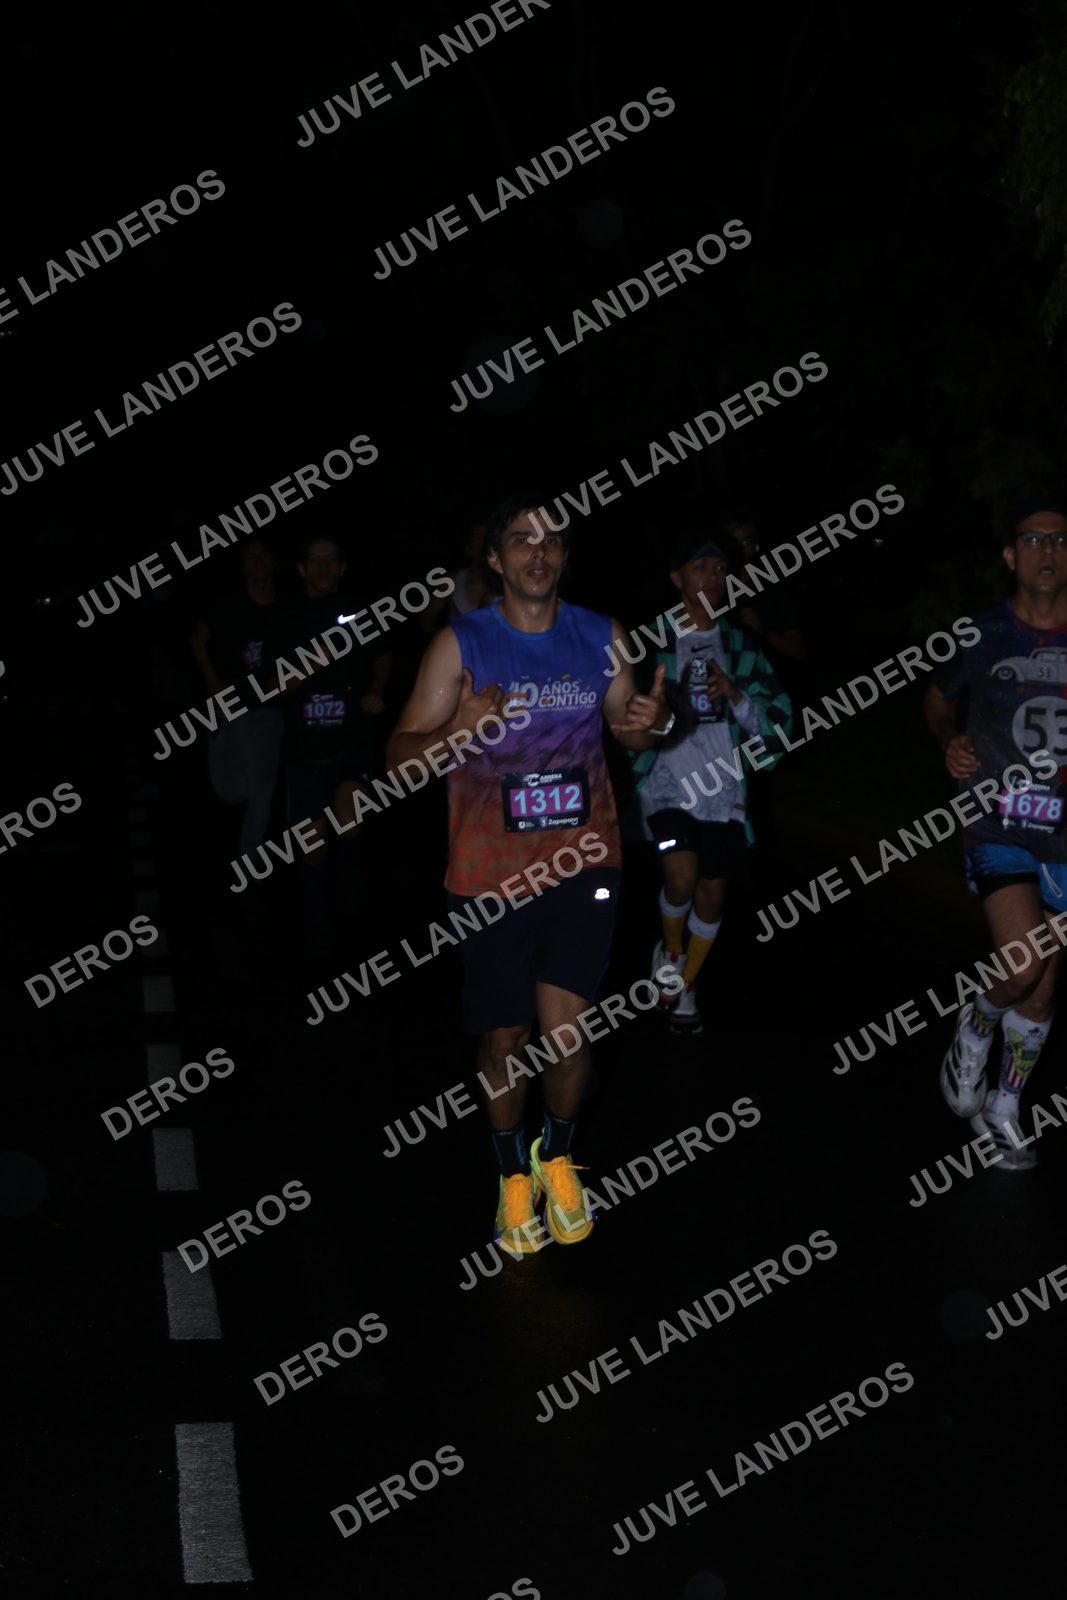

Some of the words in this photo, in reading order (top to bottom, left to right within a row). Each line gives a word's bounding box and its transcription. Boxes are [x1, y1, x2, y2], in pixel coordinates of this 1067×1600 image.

[541, 680, 580, 696] AÑOS
[305, 700, 345, 718] 1072
[538, 692, 597, 708] CONTIGO
[514, 784, 581, 815] 1312
[1005, 793, 1062, 820] 1678
